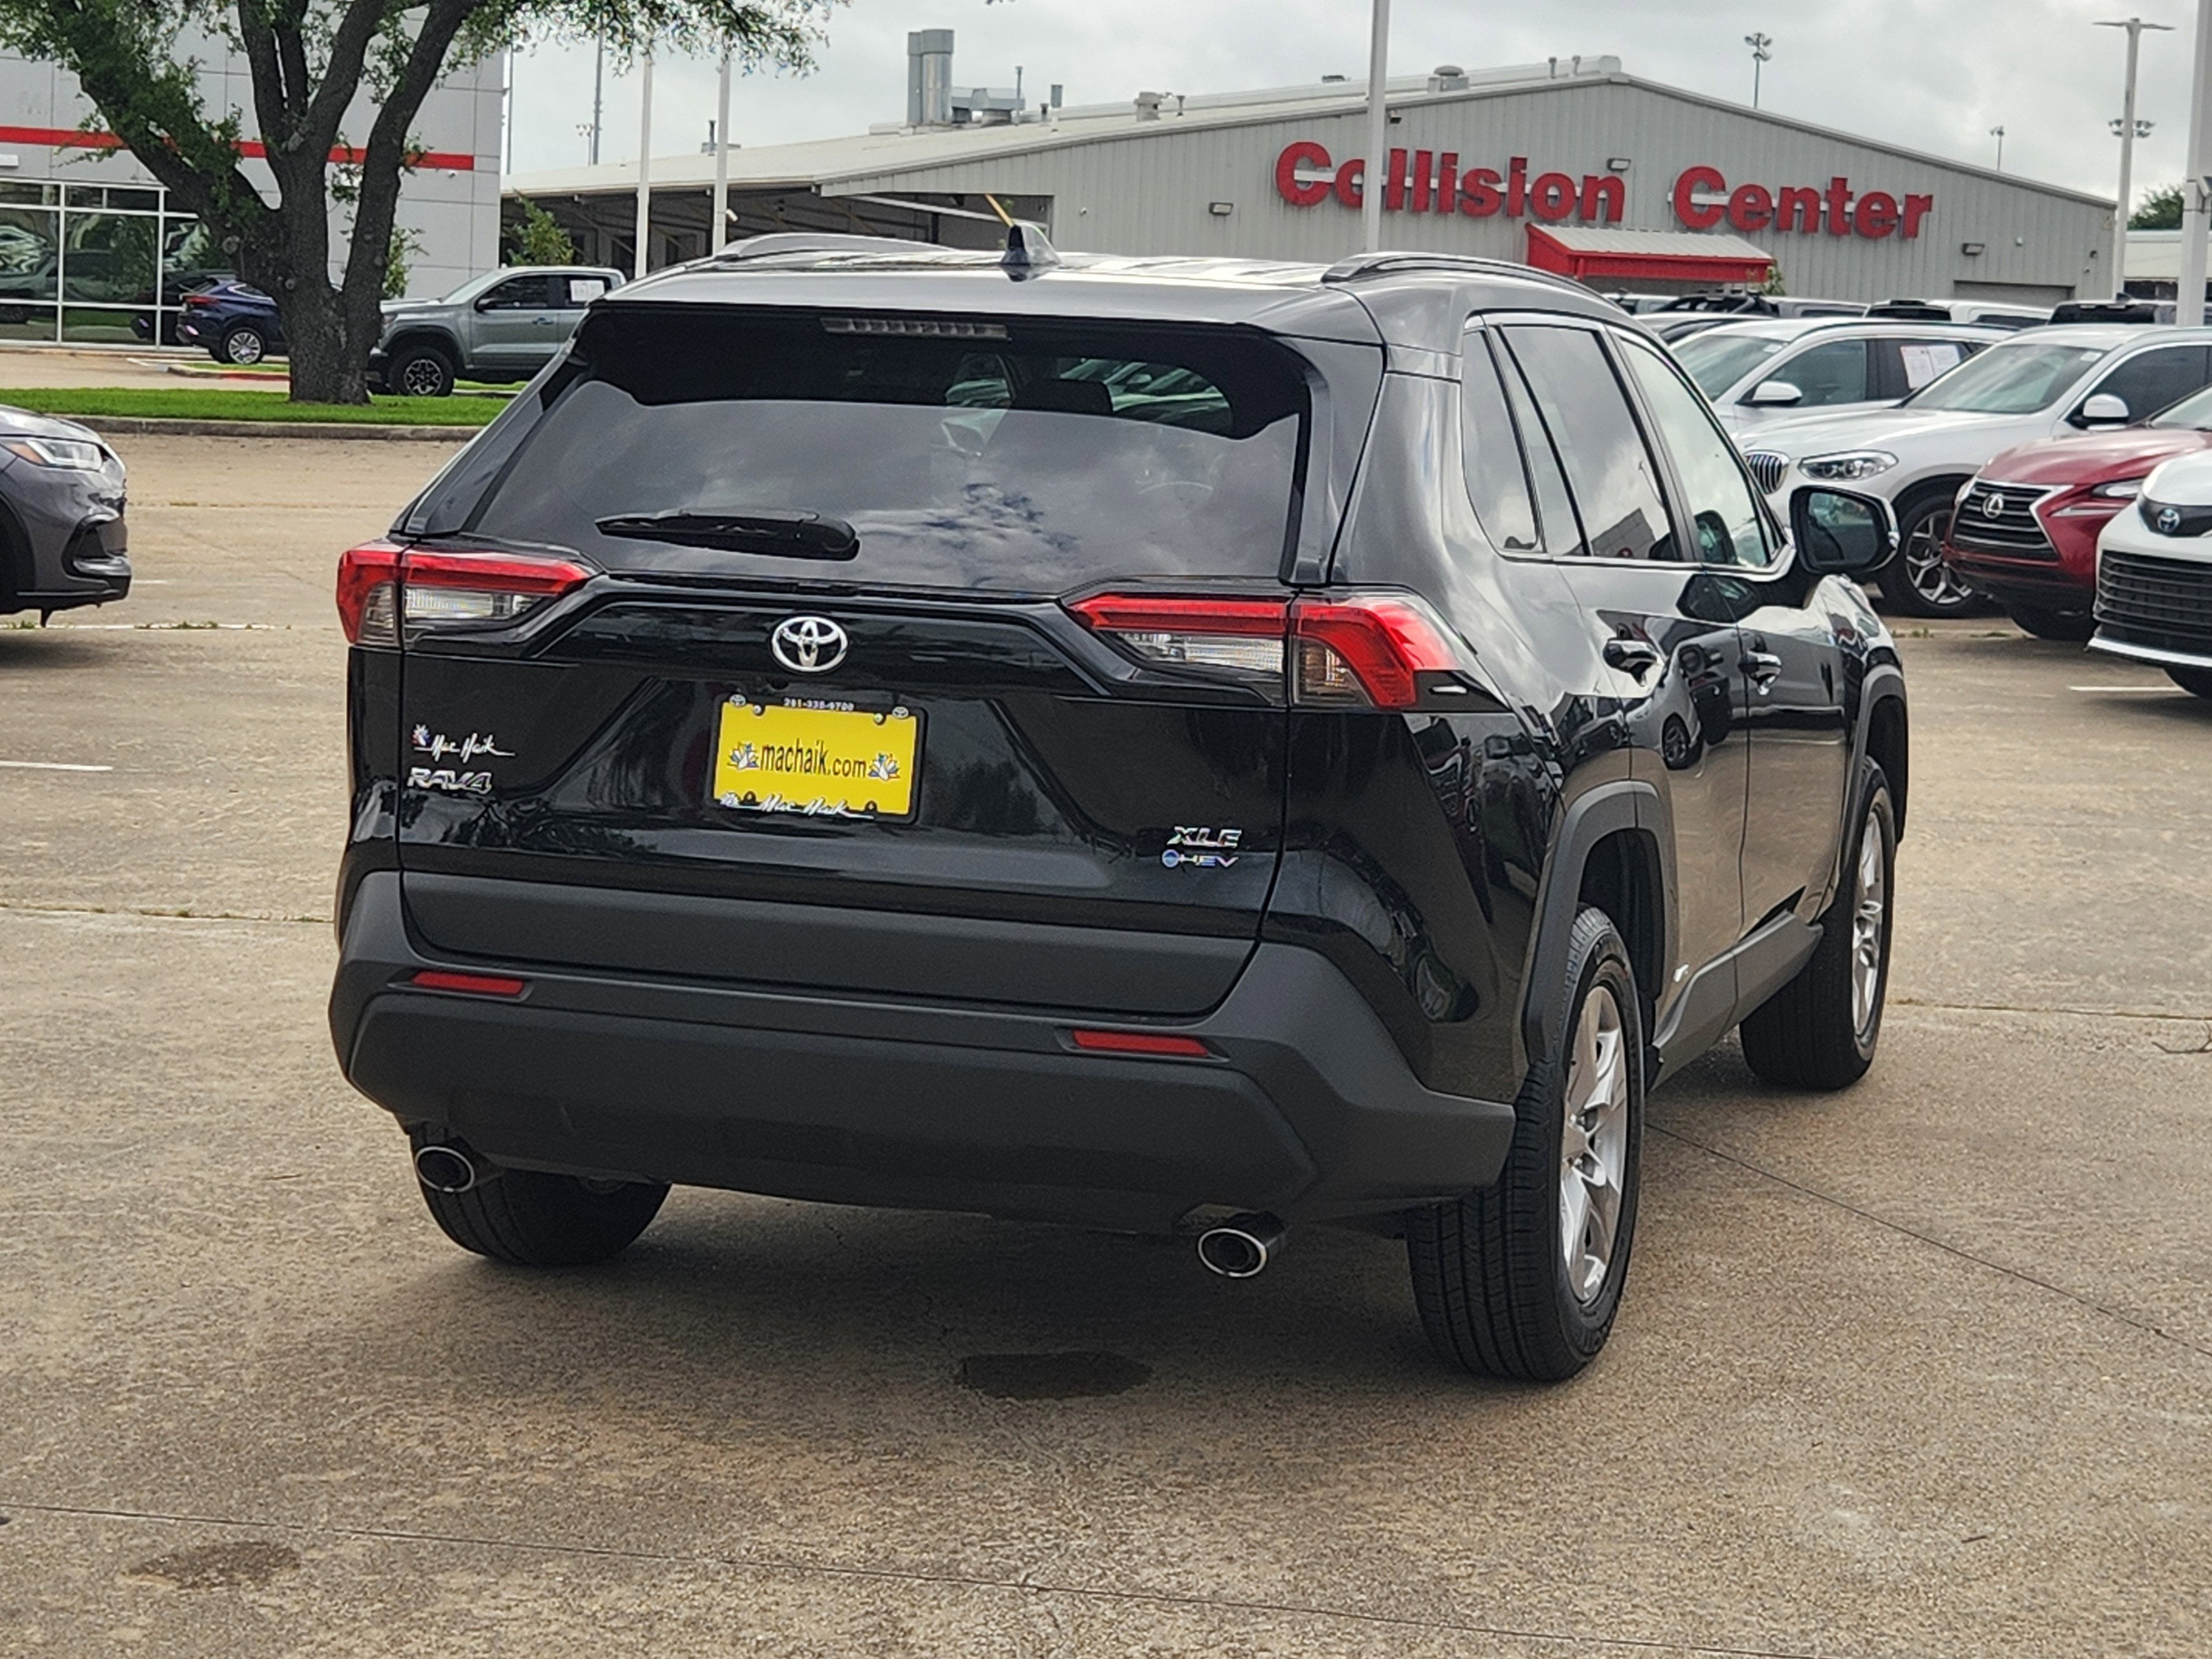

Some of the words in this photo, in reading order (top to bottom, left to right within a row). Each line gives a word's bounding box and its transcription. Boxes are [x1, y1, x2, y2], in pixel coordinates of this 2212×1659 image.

[1275, 141, 1625, 222] Collision
[1673, 166, 1934, 239] Center
[760, 737, 867, 779] machaik.com
[406, 767, 492, 795] RAV4
[1166, 826, 1243, 848] XLE
[1180, 853, 1239, 868] HEV
